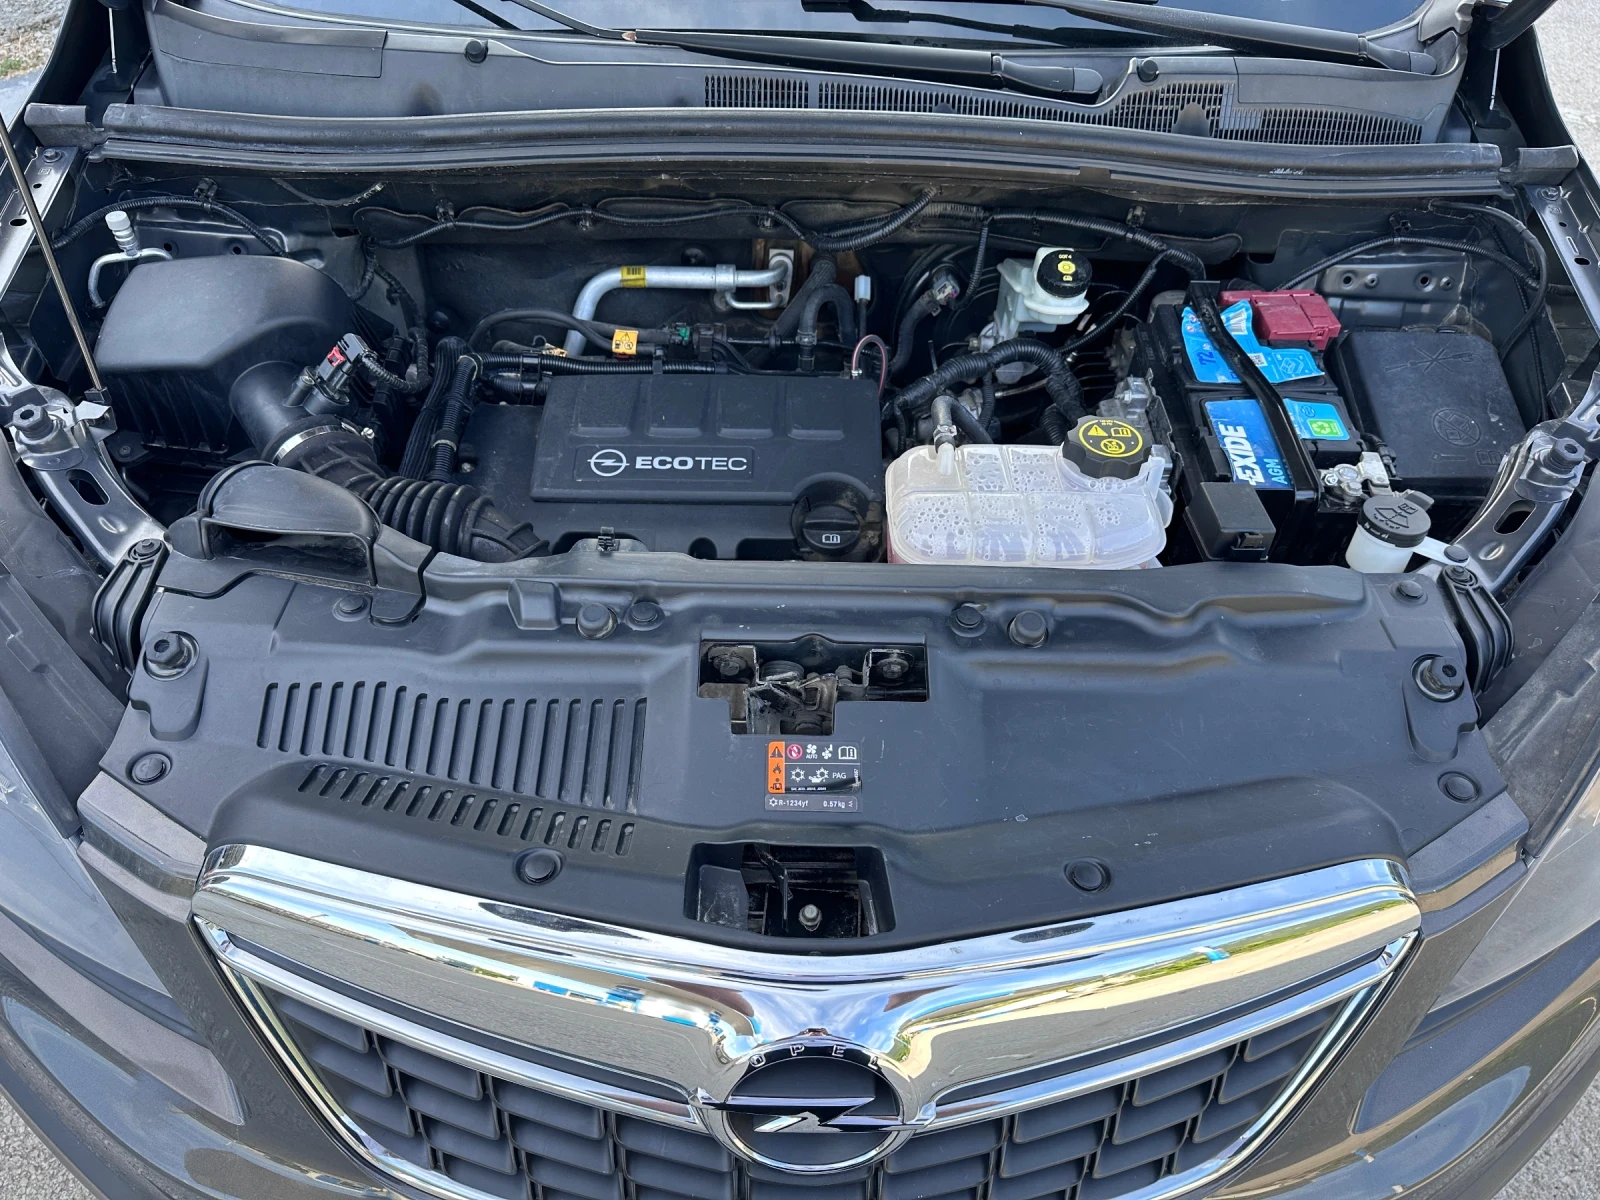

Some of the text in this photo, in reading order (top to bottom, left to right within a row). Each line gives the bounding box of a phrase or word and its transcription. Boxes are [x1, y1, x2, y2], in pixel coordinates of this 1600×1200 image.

[1197, 351, 1216, 366] 72
[635, 456, 747, 471] ECOTEC
[1218, 422, 1265, 485] EXIDE
[1263, 458, 1288, 485] AGM
[778, 800, 809, 808] R-1234yf
[749, 1044, 879, 1070] OPEL
